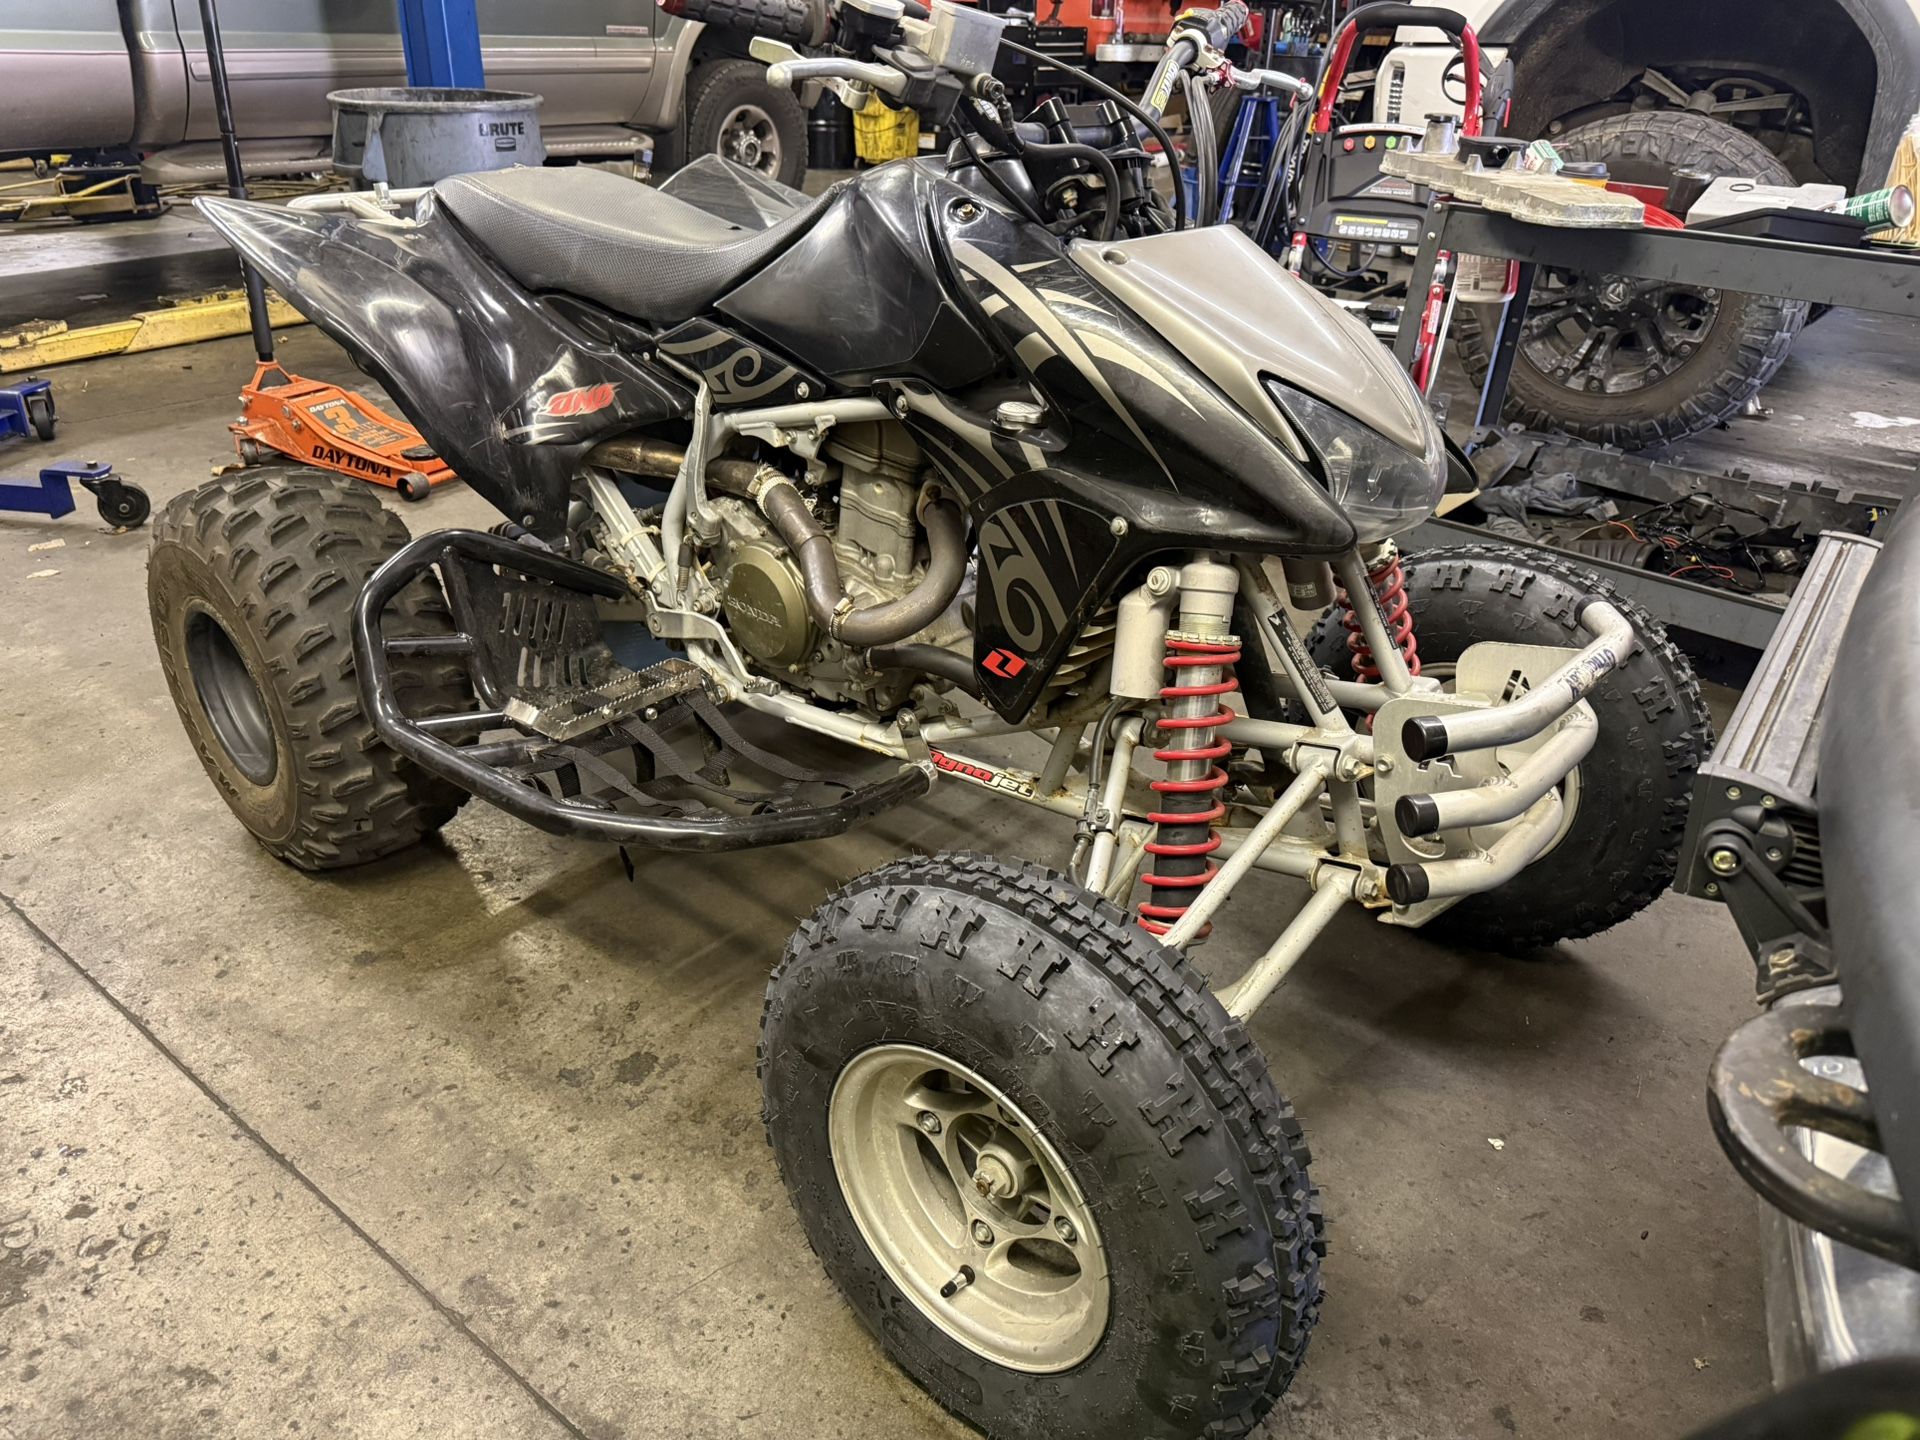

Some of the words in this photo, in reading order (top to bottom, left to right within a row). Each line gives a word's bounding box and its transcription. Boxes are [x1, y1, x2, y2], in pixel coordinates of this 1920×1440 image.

[309, 399, 347, 413] DAYTONA
[324, 406, 360, 434] 3
[312, 445, 392, 478] DAYTONA
[727, 594, 783, 628] HONDA
